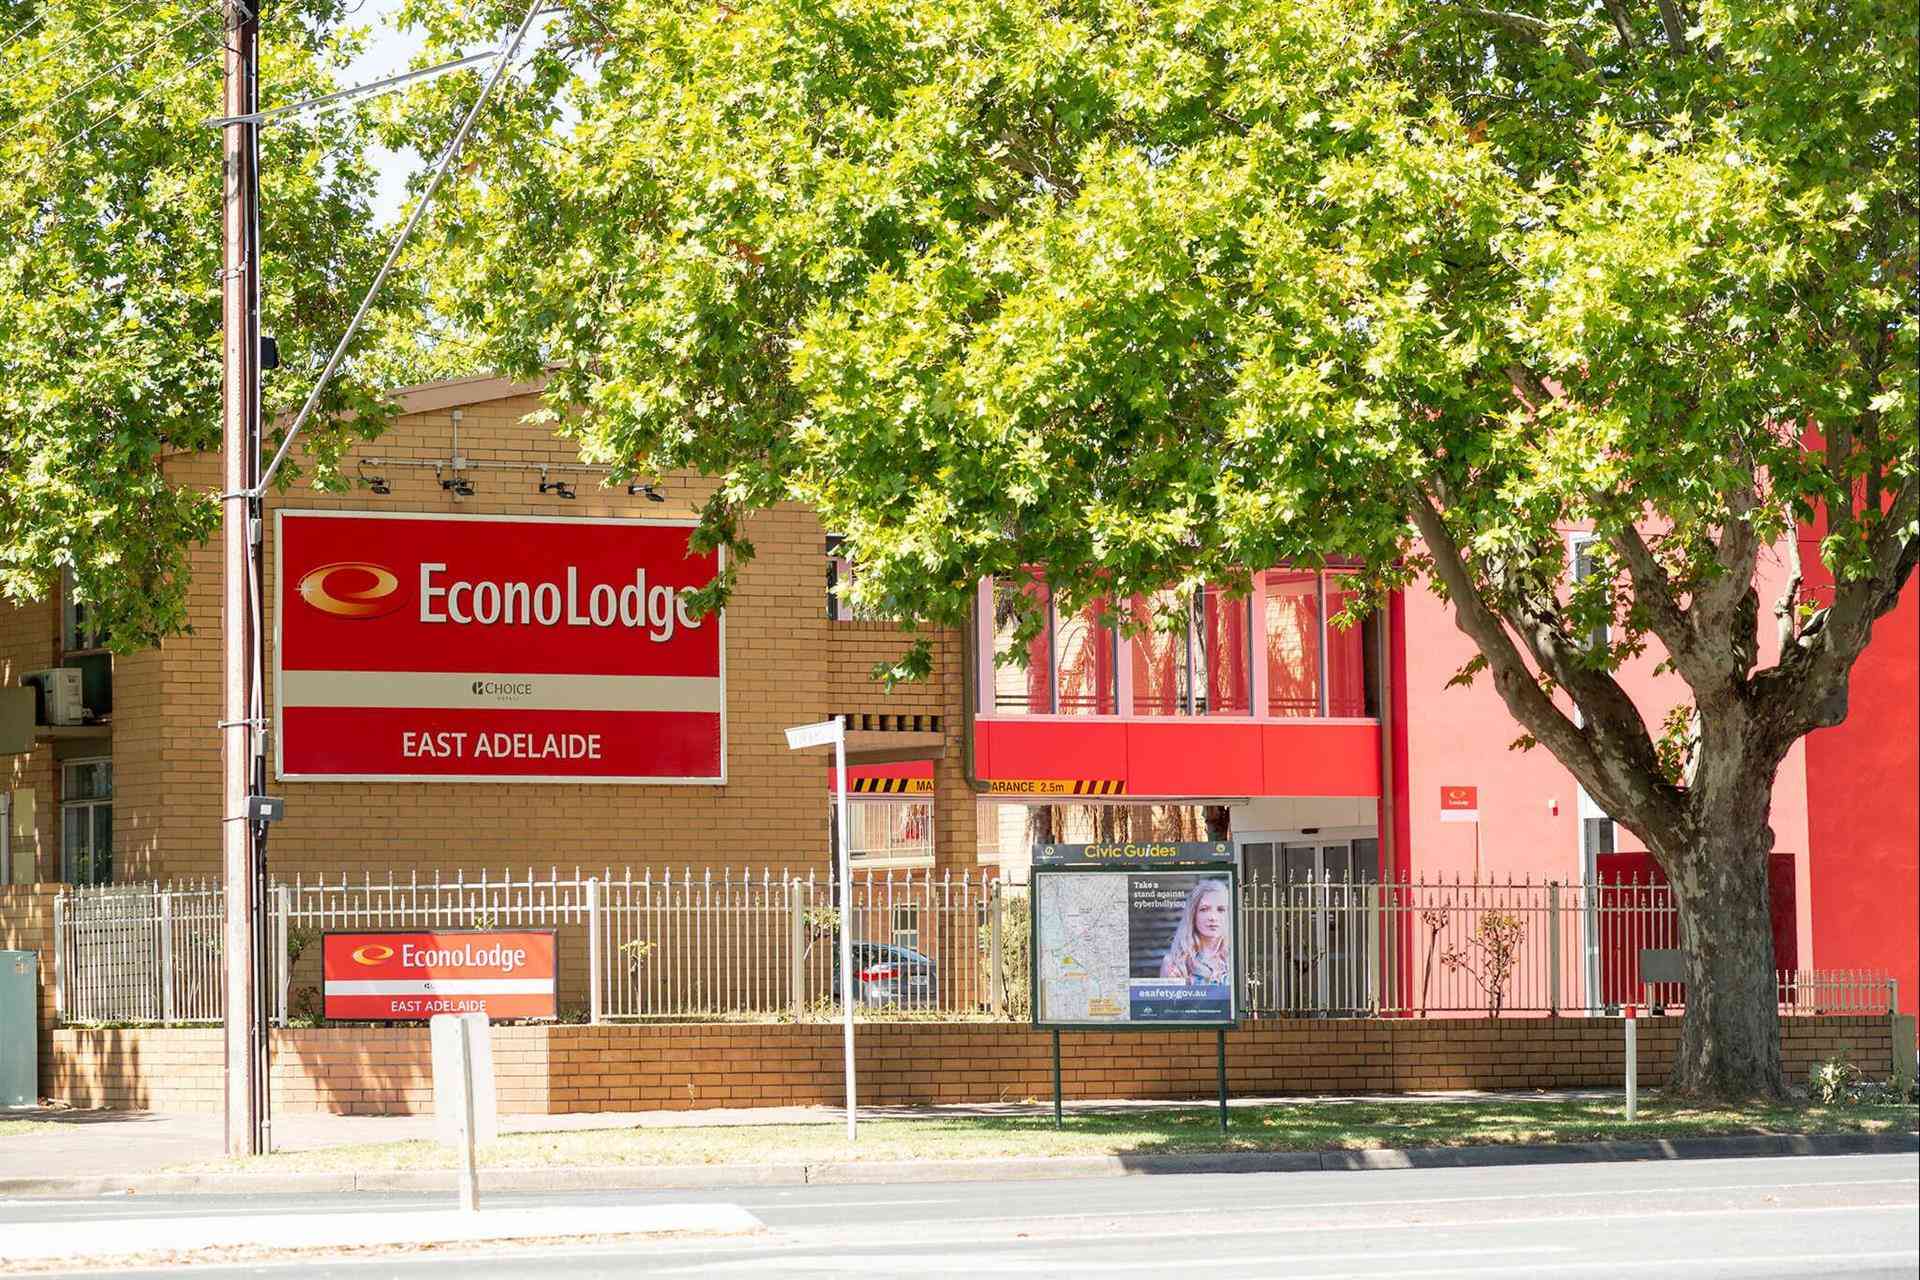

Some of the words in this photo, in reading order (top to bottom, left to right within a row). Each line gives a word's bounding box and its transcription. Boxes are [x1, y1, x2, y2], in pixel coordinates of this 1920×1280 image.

[420, 562, 702, 642] EconoLodge
[485, 682, 533, 695] CHOICE
[403, 732, 467, 758] EAST
[474, 733, 601, 759] ADELAIDE
[1040, 782, 1064, 793] 2.5m
[1084, 844, 1121, 858] Civic
[1124, 844, 1176, 858] Guides
[1134, 881, 1152, 889] Take
[1134, 890, 1155, 898] stand
[1157, 890, 1185, 899] against
[1134, 900, 1186, 909] cyberbullying
[402, 943, 526, 971] EconoLodge
[1138, 988, 1207, 1000] esafety.gov.au
[391, 1001, 422, 1012] EAST
[425, 1000, 486, 1012] ADELAIDE
